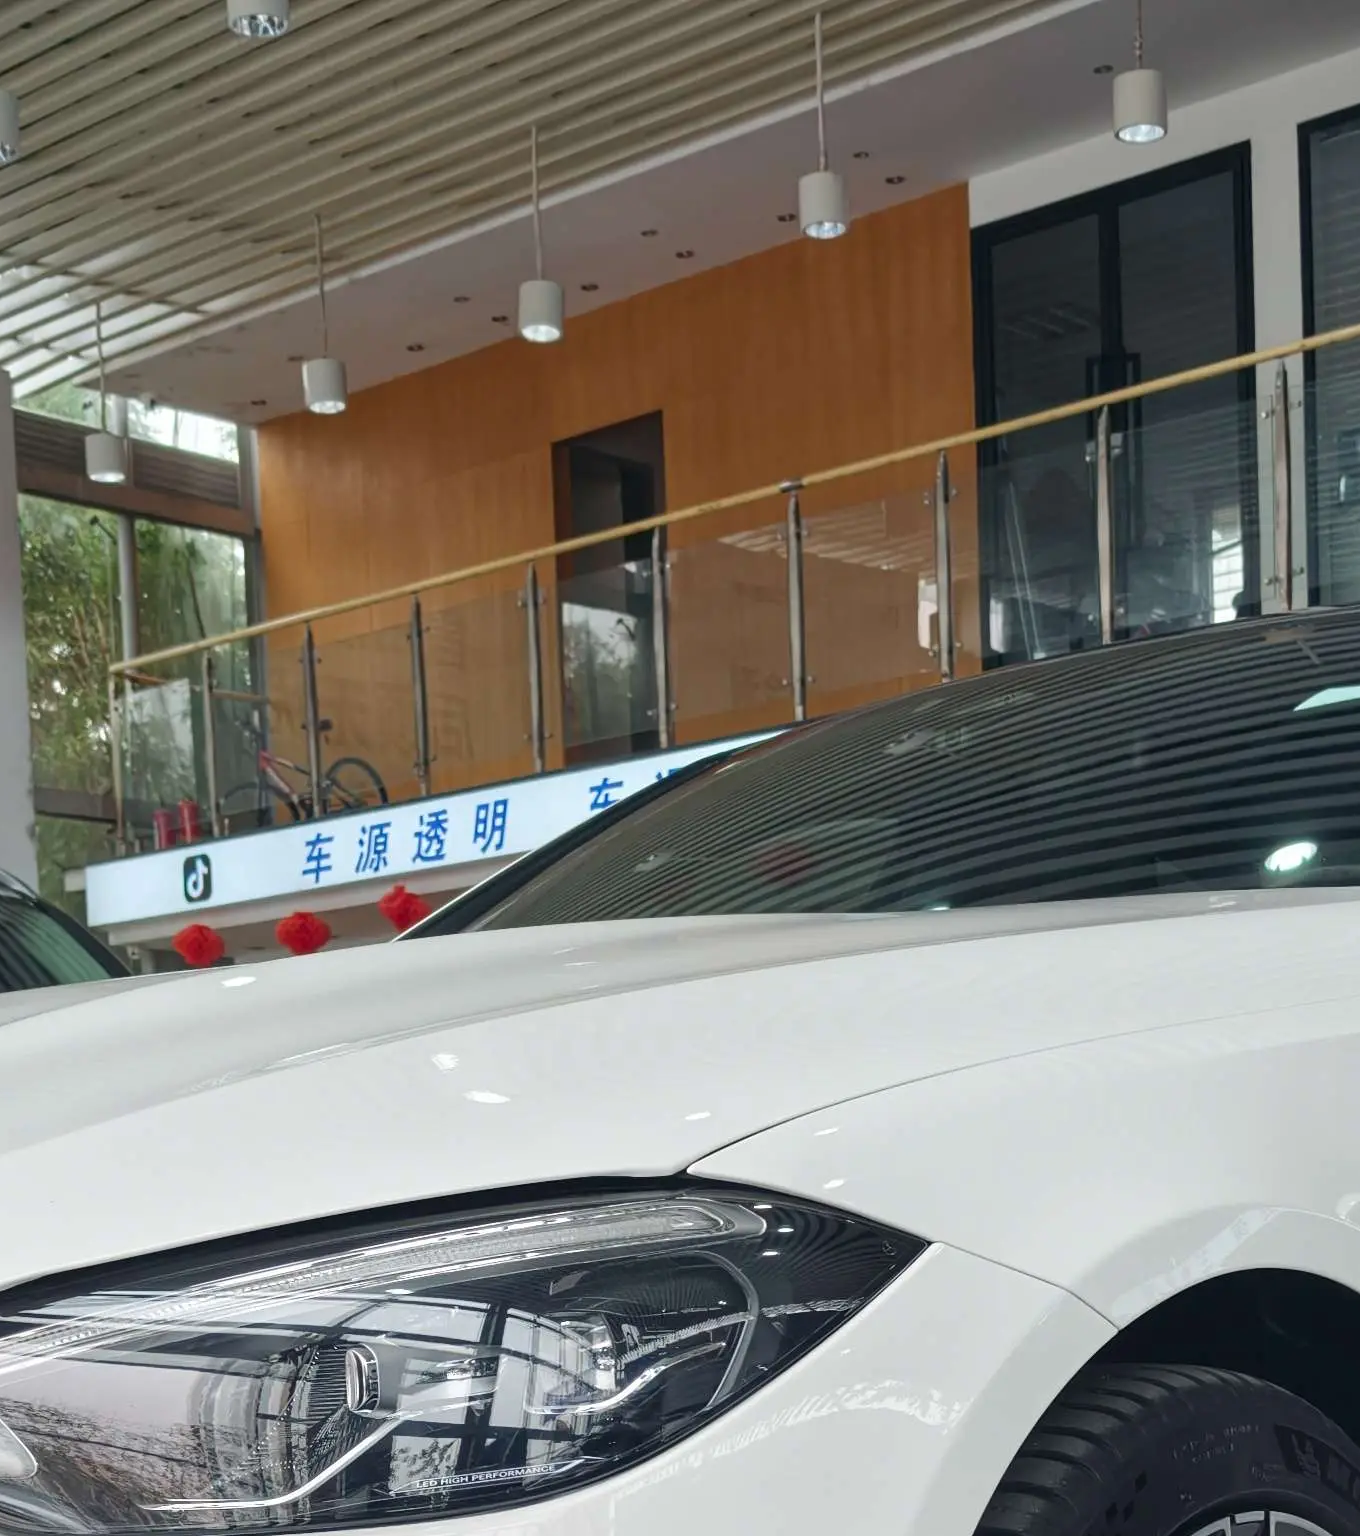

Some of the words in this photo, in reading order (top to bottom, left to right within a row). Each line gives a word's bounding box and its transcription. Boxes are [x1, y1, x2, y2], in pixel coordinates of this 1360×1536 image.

[302, 798, 509, 884] 车源透明
[416, 1478, 437, 1489] LED
[441, 1475, 469, 1486] HIGH
[472, 1464, 555, 1482] PERFORMANCE
